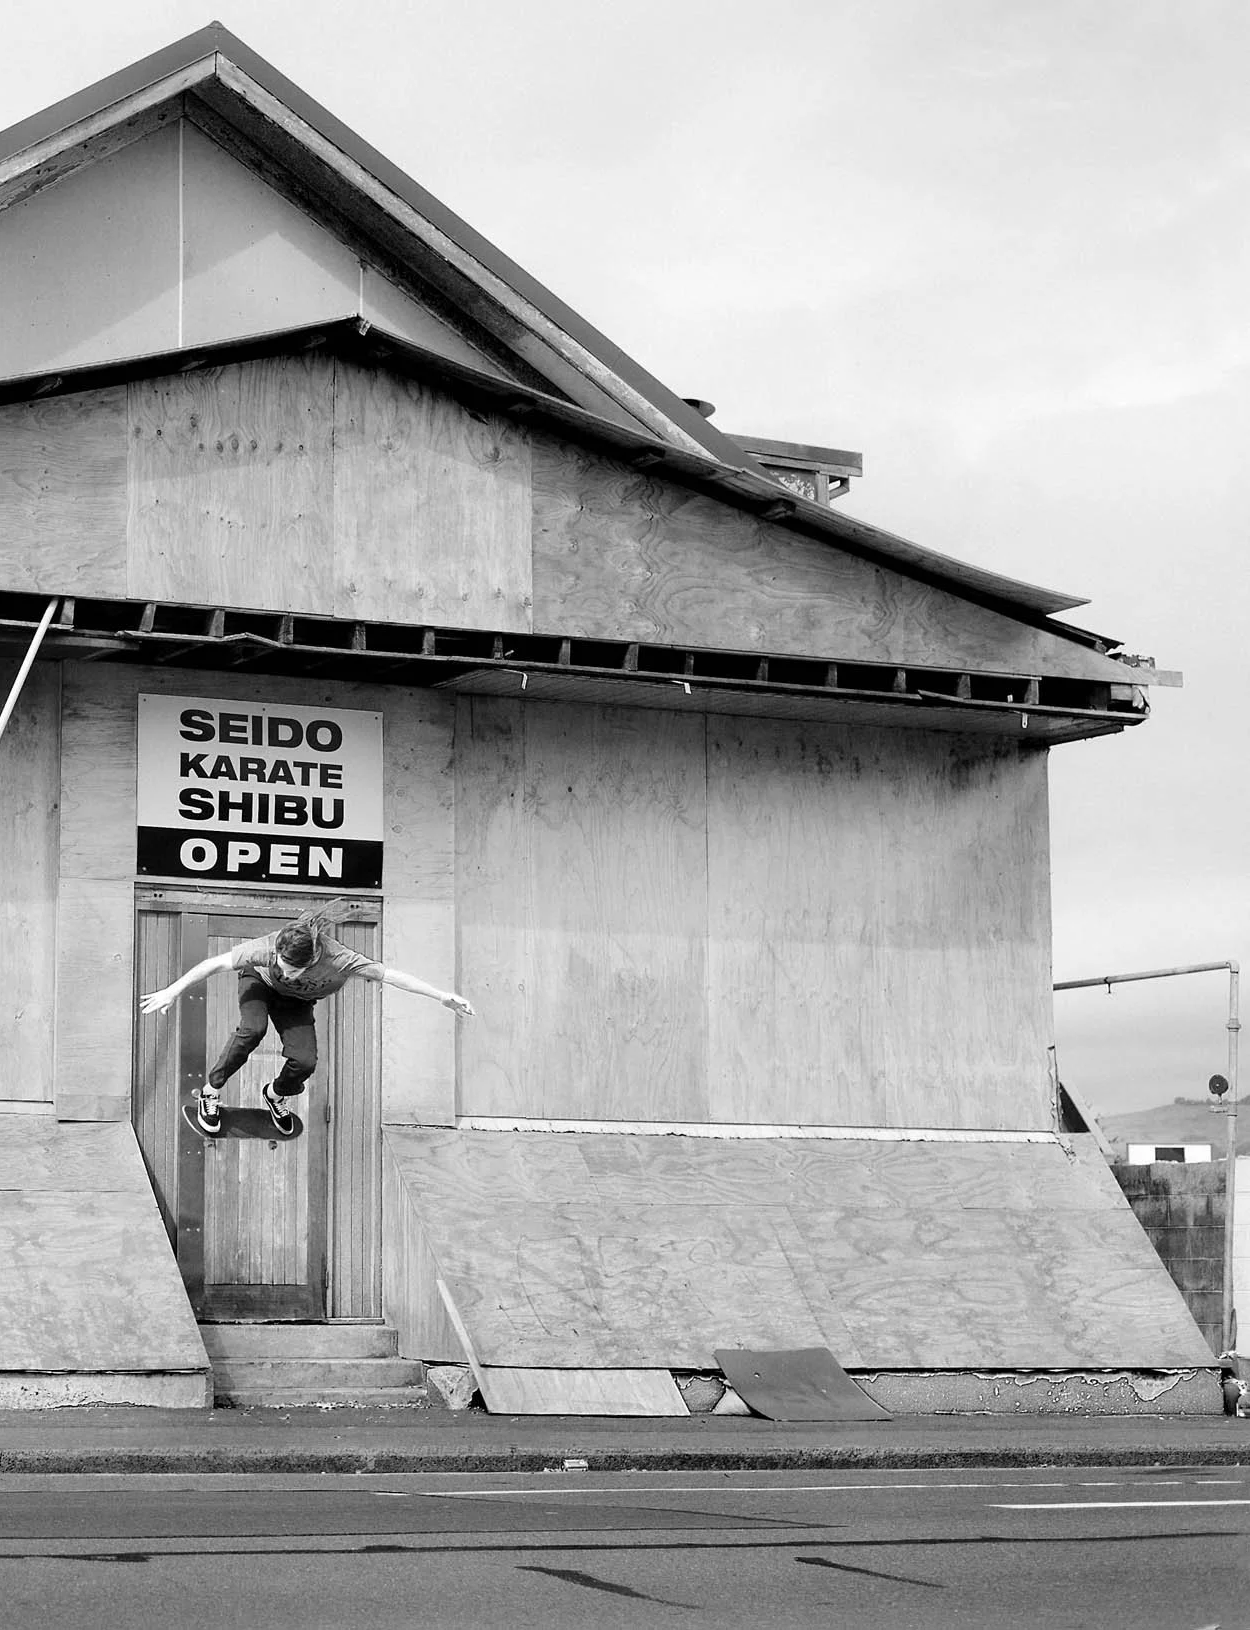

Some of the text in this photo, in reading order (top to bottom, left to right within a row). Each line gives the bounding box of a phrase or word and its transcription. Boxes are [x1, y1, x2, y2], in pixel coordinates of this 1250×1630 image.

[179, 709, 343, 752] SEIDO
[180, 752, 343, 789] KARATE
[178, 787, 344, 829] SHIBU
[180, 838, 343, 878] OPEN
